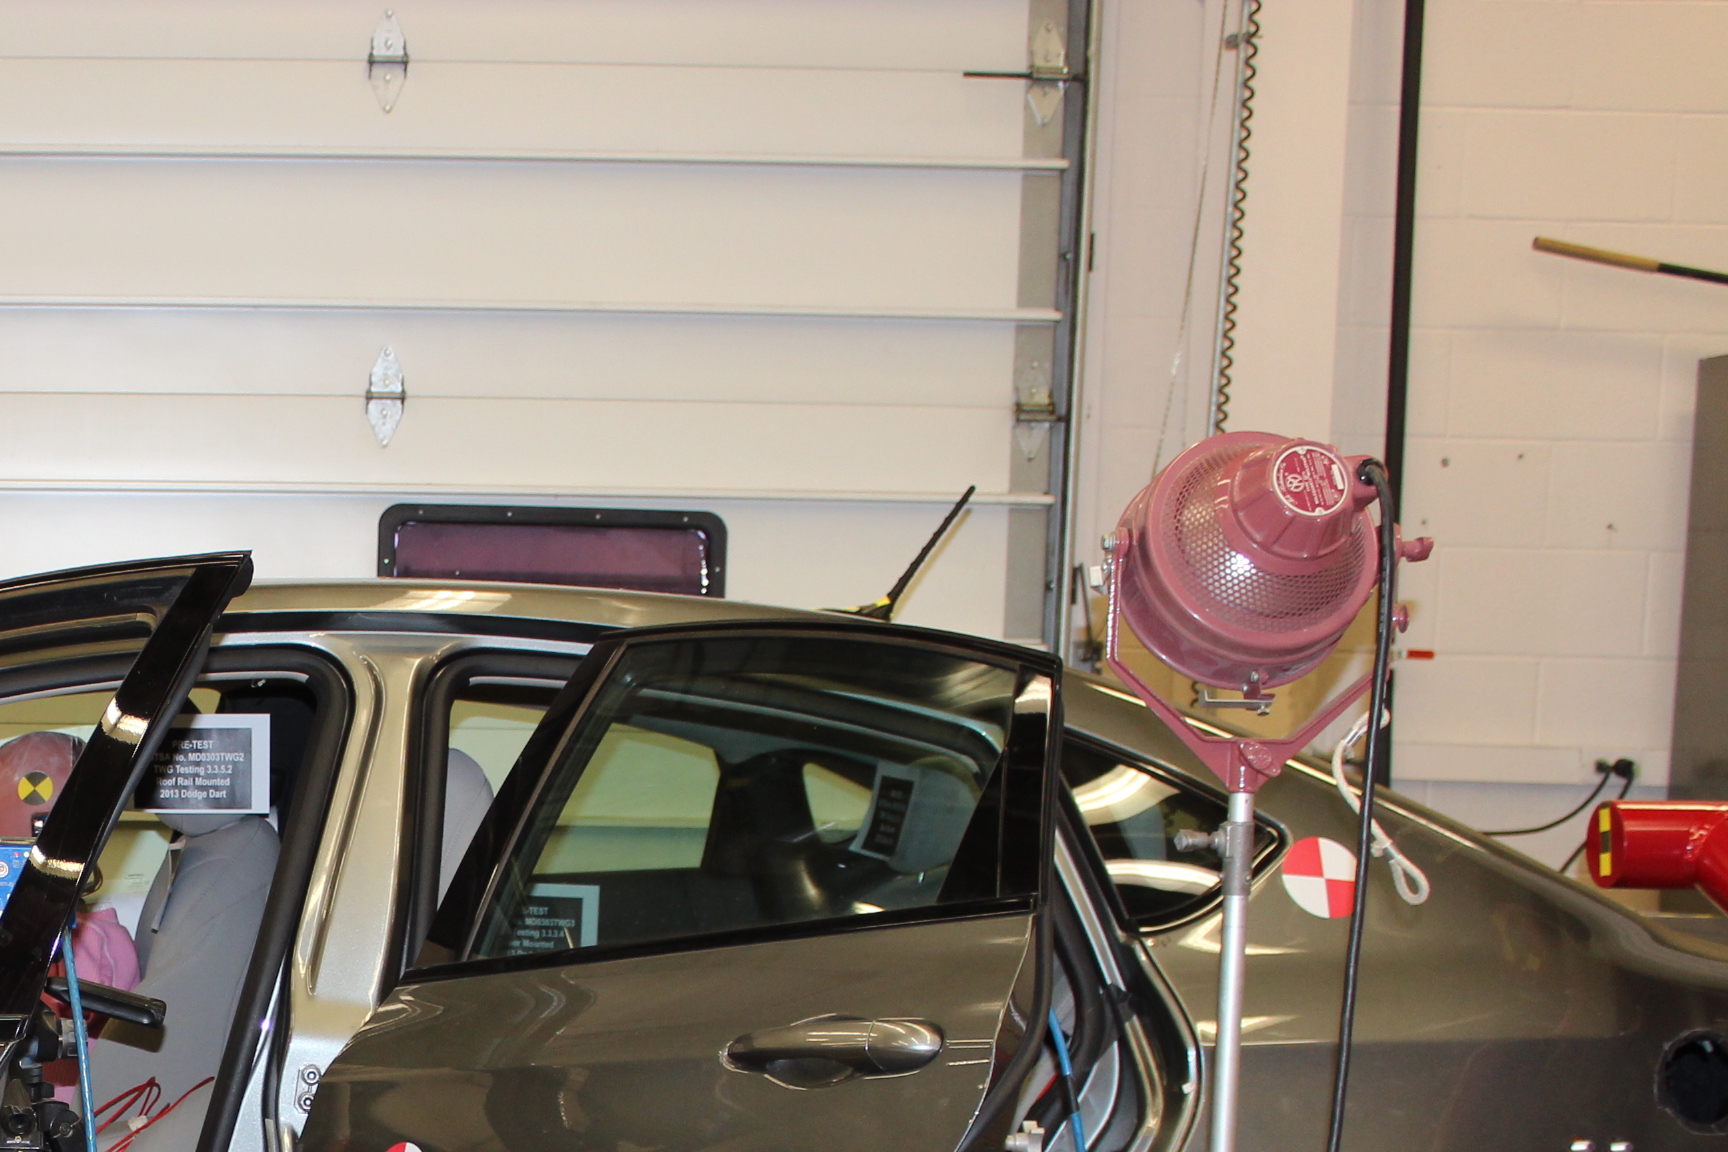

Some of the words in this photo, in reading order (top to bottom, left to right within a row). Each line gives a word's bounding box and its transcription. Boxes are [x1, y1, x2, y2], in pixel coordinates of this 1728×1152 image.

[176, 765, 205, 775] Testing
[177, 777, 193, 786] Rail
[195, 777, 230, 786] Mounted
[160, 789, 179, 798] 2013
[181, 789, 207, 799] Dodge
[209, 789, 227, 798] Dart
